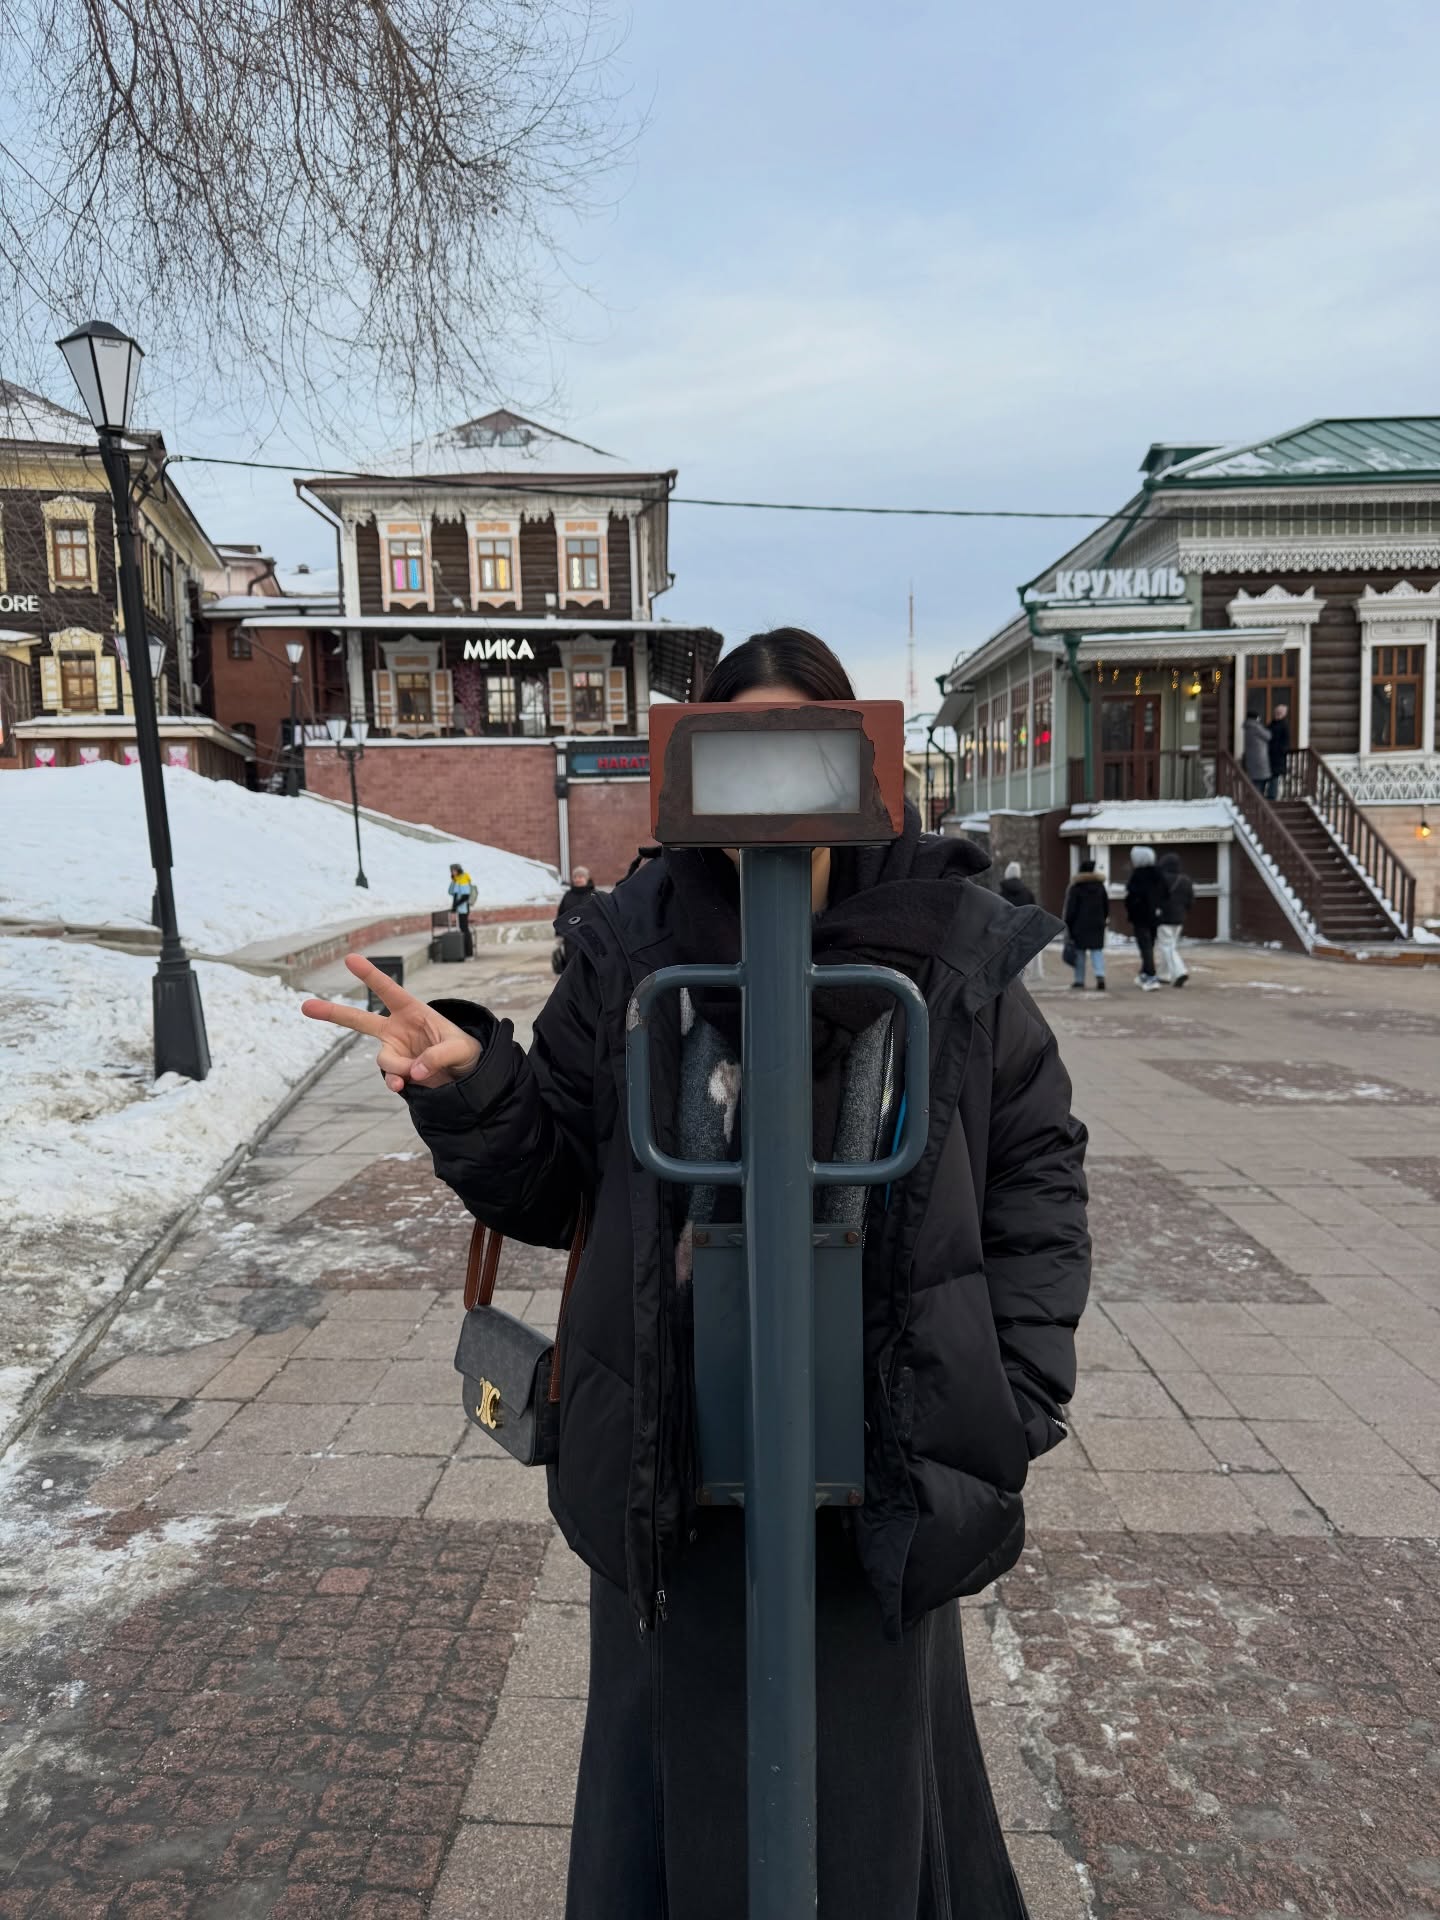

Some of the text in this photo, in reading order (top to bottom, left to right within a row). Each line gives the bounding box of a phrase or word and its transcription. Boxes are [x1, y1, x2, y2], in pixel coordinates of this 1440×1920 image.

[1055, 567, 1186, 600] КРУЖАЛЬ
[0, 594, 40, 612] ORE
[463, 638, 535, 660] МИКА
[597, 756, 649, 769] HARAT
